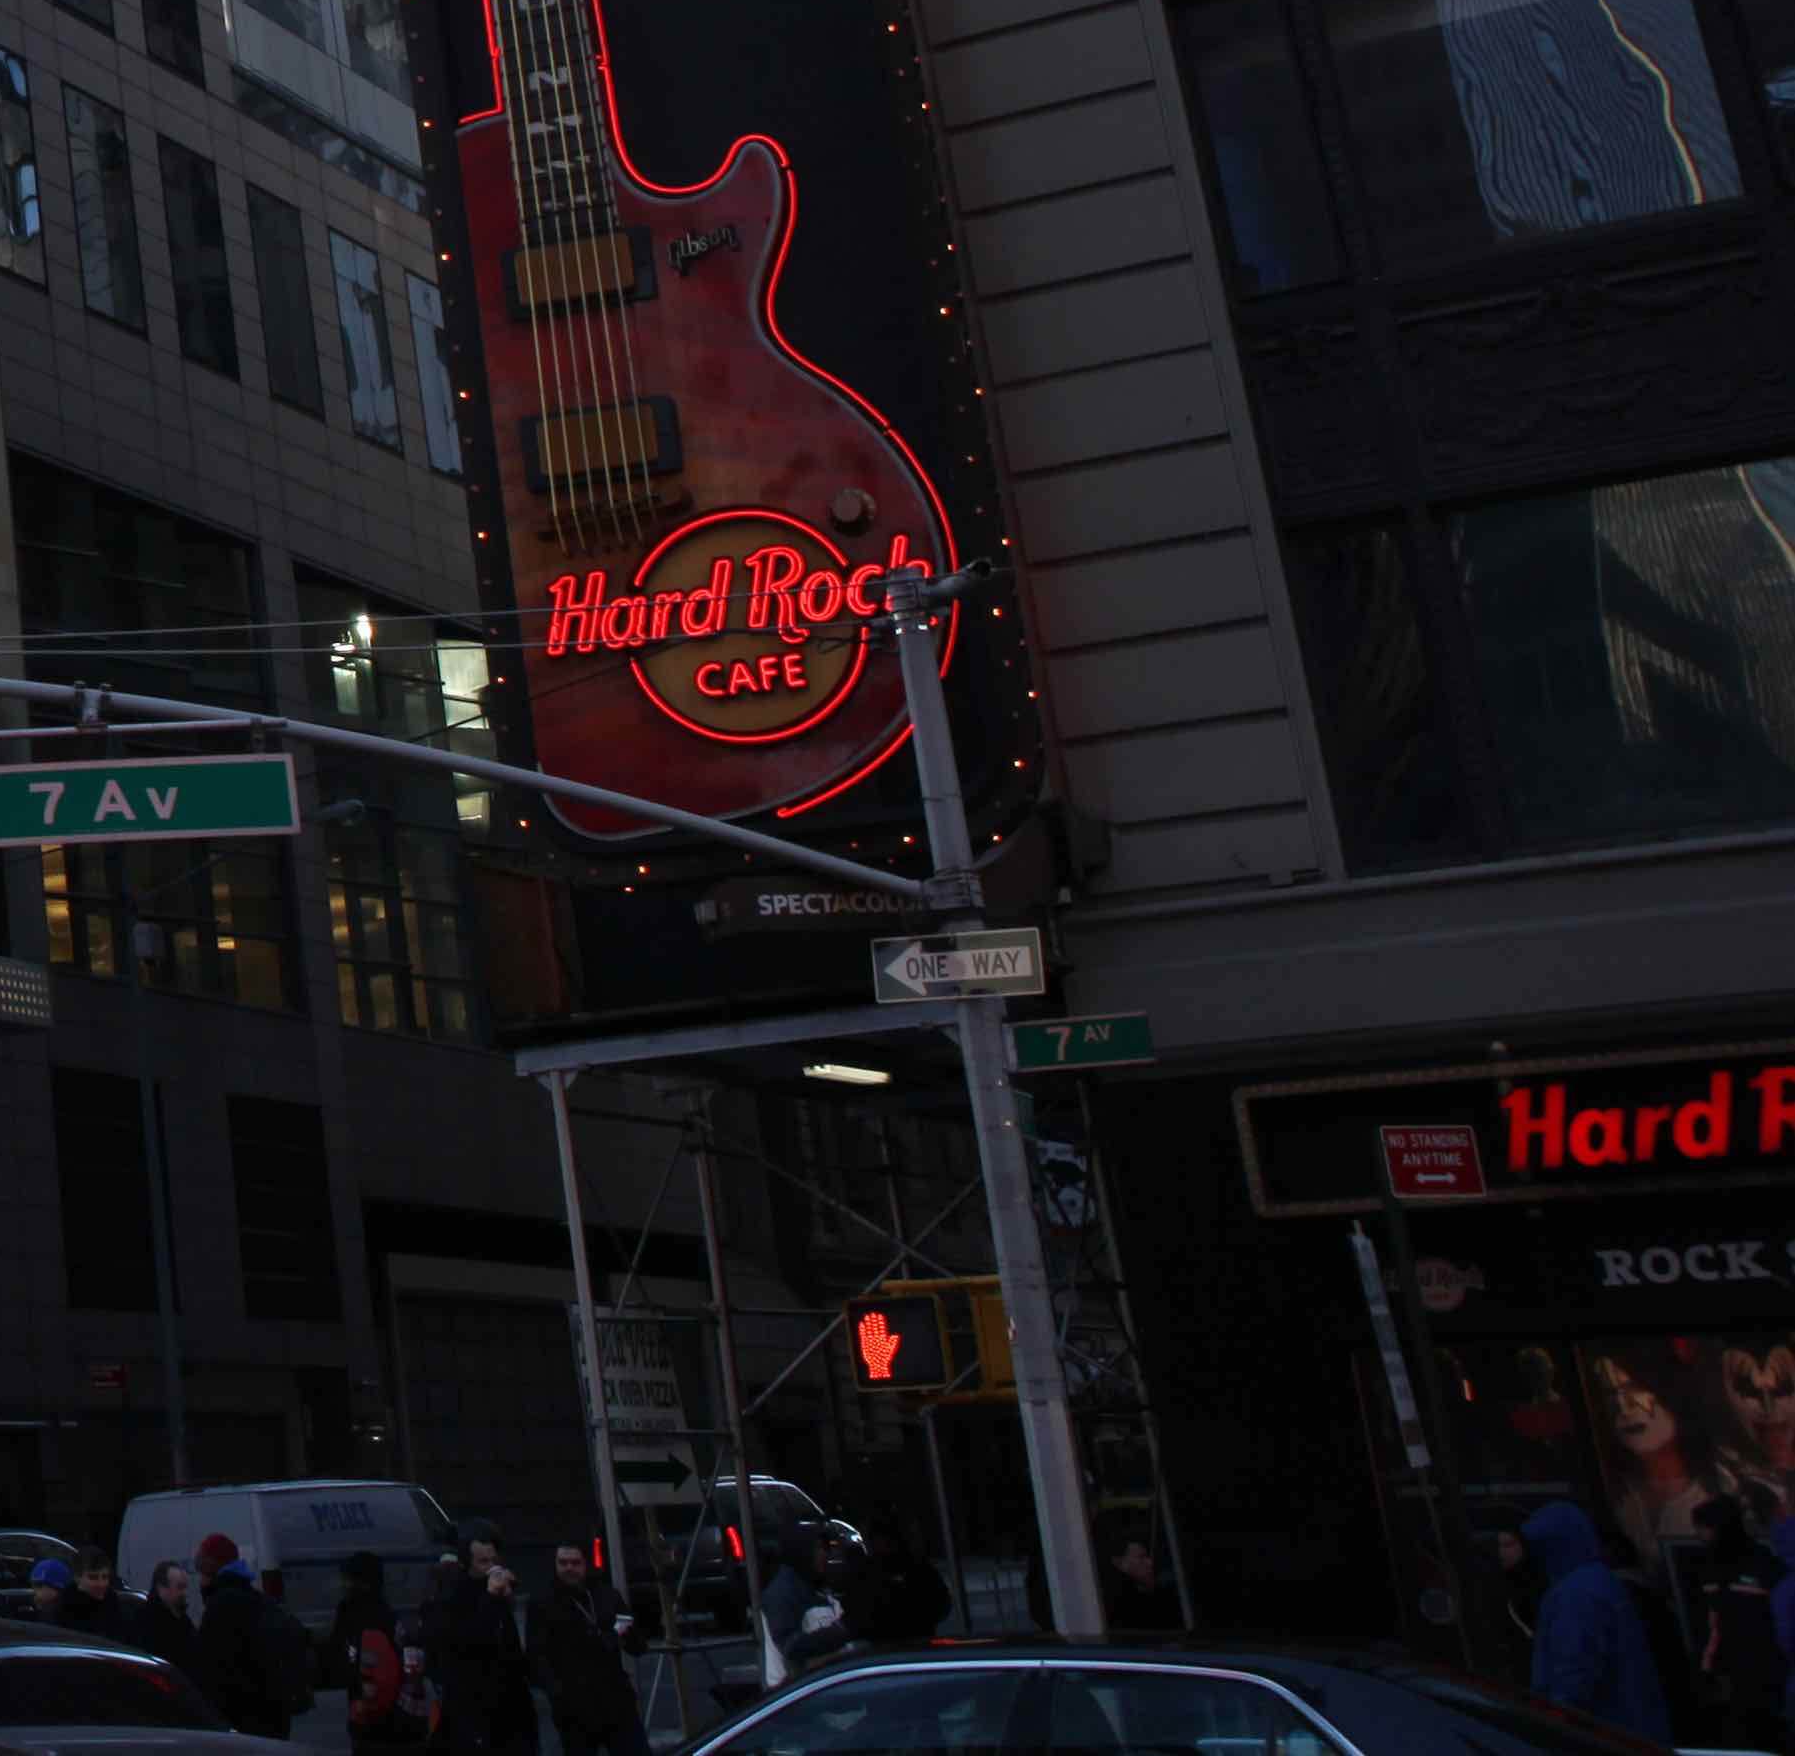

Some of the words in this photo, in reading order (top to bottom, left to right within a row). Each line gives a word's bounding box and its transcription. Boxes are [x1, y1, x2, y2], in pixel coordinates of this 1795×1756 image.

[547, 559, 733, 656] Hard
[695, 653, 808, 697] CAFE
[28, 781, 65, 825] 7
[95, 779, 179, 823] Av
[905, 954, 949, 981] ONE
[972, 950, 1022, 976] WAY
[1046, 1025, 1072, 1062] 7
[1083, 1022, 1112, 1044] AV
[1499, 1066, 1737, 1171] Hard
[1401, 1151, 1465, 1166] ANYTIME
[1597, 1240, 1772, 1289] ROCK
[311, 1502, 376, 1532] POLICE
